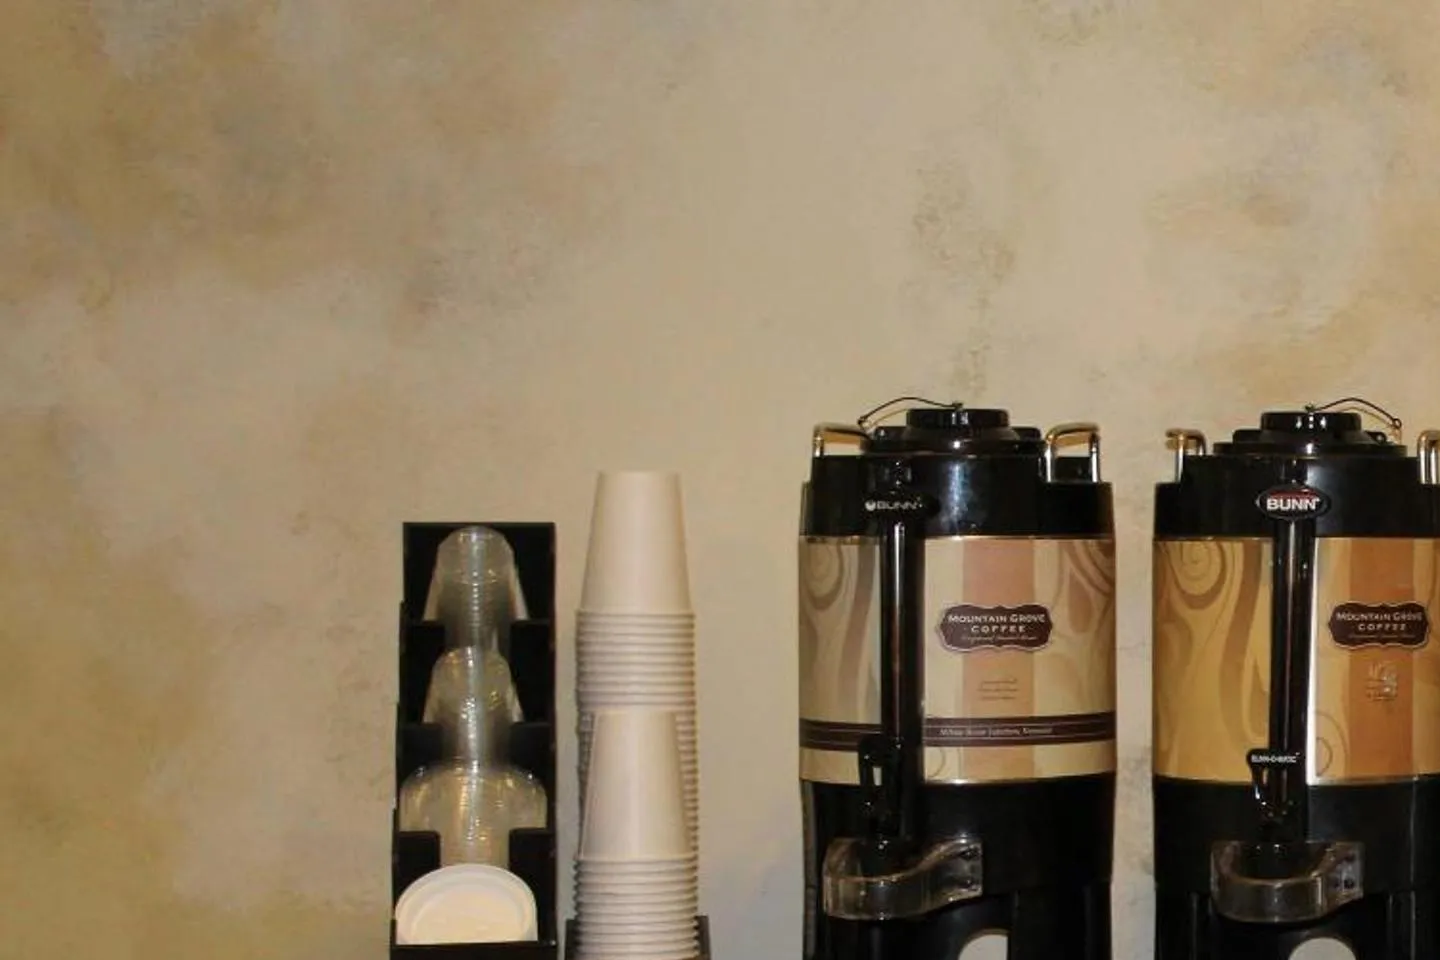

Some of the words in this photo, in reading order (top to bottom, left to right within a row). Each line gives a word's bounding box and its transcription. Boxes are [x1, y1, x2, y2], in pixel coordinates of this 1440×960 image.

[1266, 497, 1317, 511] BUNN
[948, 614, 1007, 624] MOUNTAIN
[1009, 613, 1046, 623] GROVE
[1336, 611, 1391, 621] MOUNTAIN
[971, 625, 1027, 634] COFFEE
